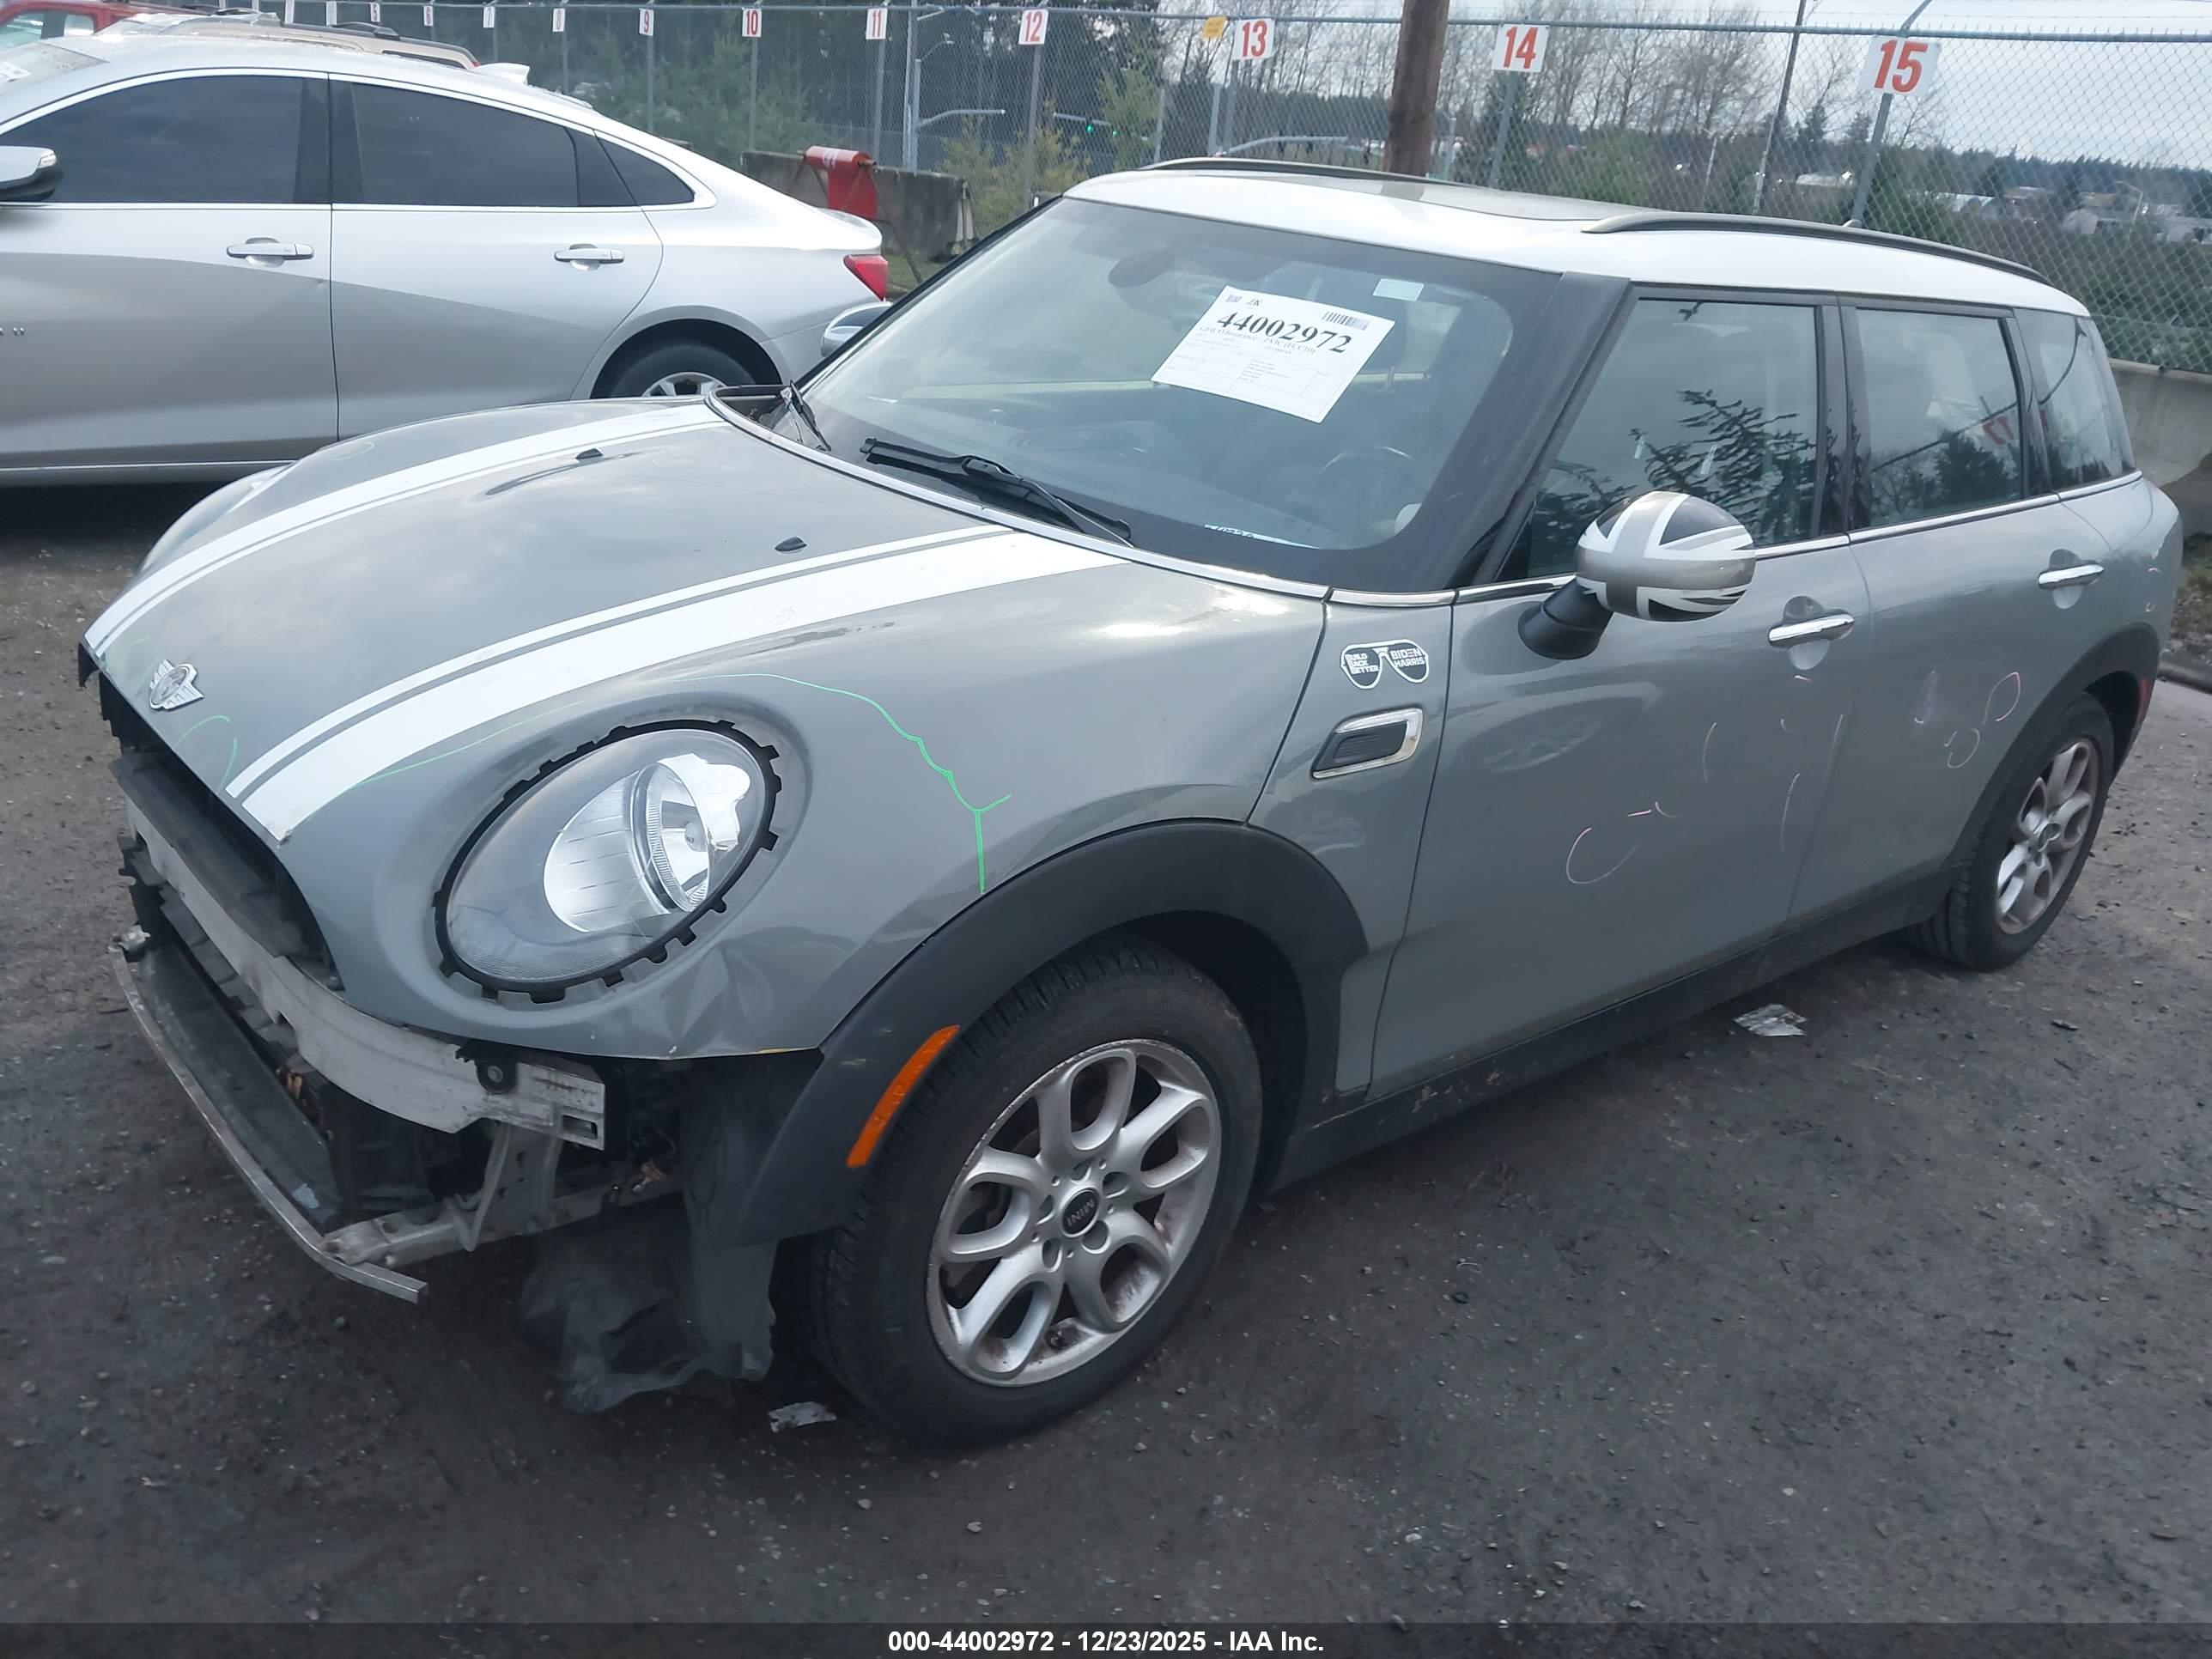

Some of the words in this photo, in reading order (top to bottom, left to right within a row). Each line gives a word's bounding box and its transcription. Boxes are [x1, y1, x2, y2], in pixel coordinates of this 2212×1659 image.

[643, 13, 650, 33] 9
[745, 10, 758, 36] 10
[872, 12, 883, 37] 11
[1024, 12, 1042, 42] 12
[1241, 20, 1268, 58] 13
[1503, 27, 1540, 69] 14
[1875, 40, 1929, 93] 15
[1217, 312, 1352, 353] 44002972
[1345, 653, 1368, 661] BUILD
[1348, 659, 1369, 668] BACK
[1390, 647, 1423, 660] BIDEN
[1393, 657, 1425, 669] HARRIS
[1351, 665, 1379, 675] BETTER
[1066, 1199, 1095, 1227] MINI
